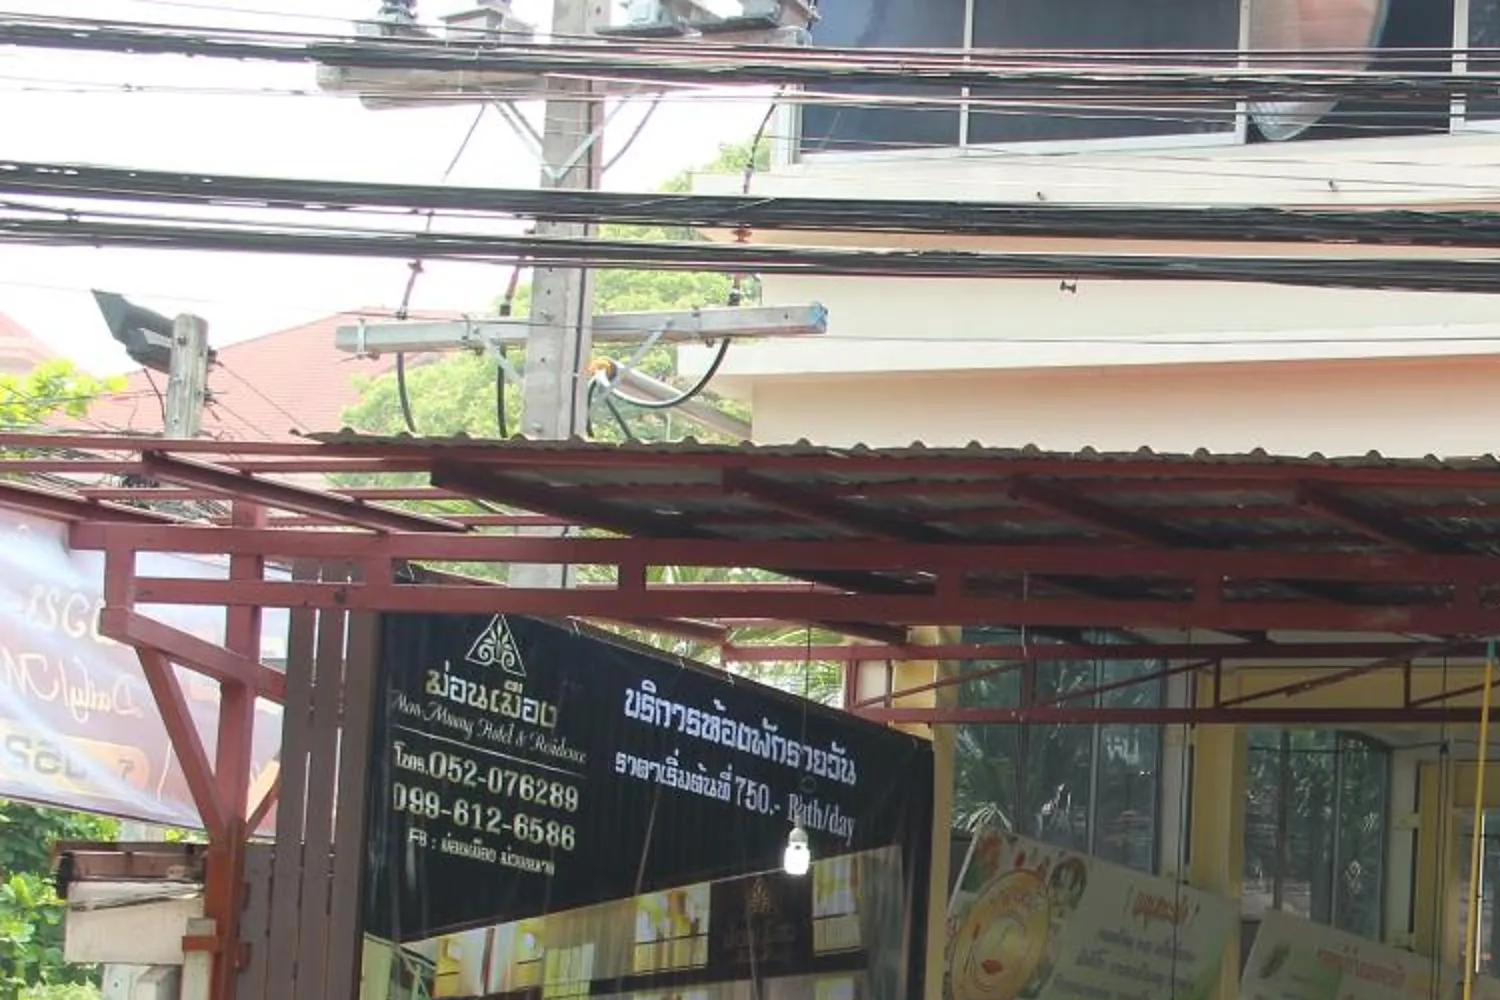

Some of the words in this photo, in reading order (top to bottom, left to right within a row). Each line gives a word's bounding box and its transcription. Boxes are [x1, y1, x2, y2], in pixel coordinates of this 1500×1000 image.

[624, 680, 857, 786] บริการห้องพักรายวัน
[393, 783, 576, 851] 099-612-6586
